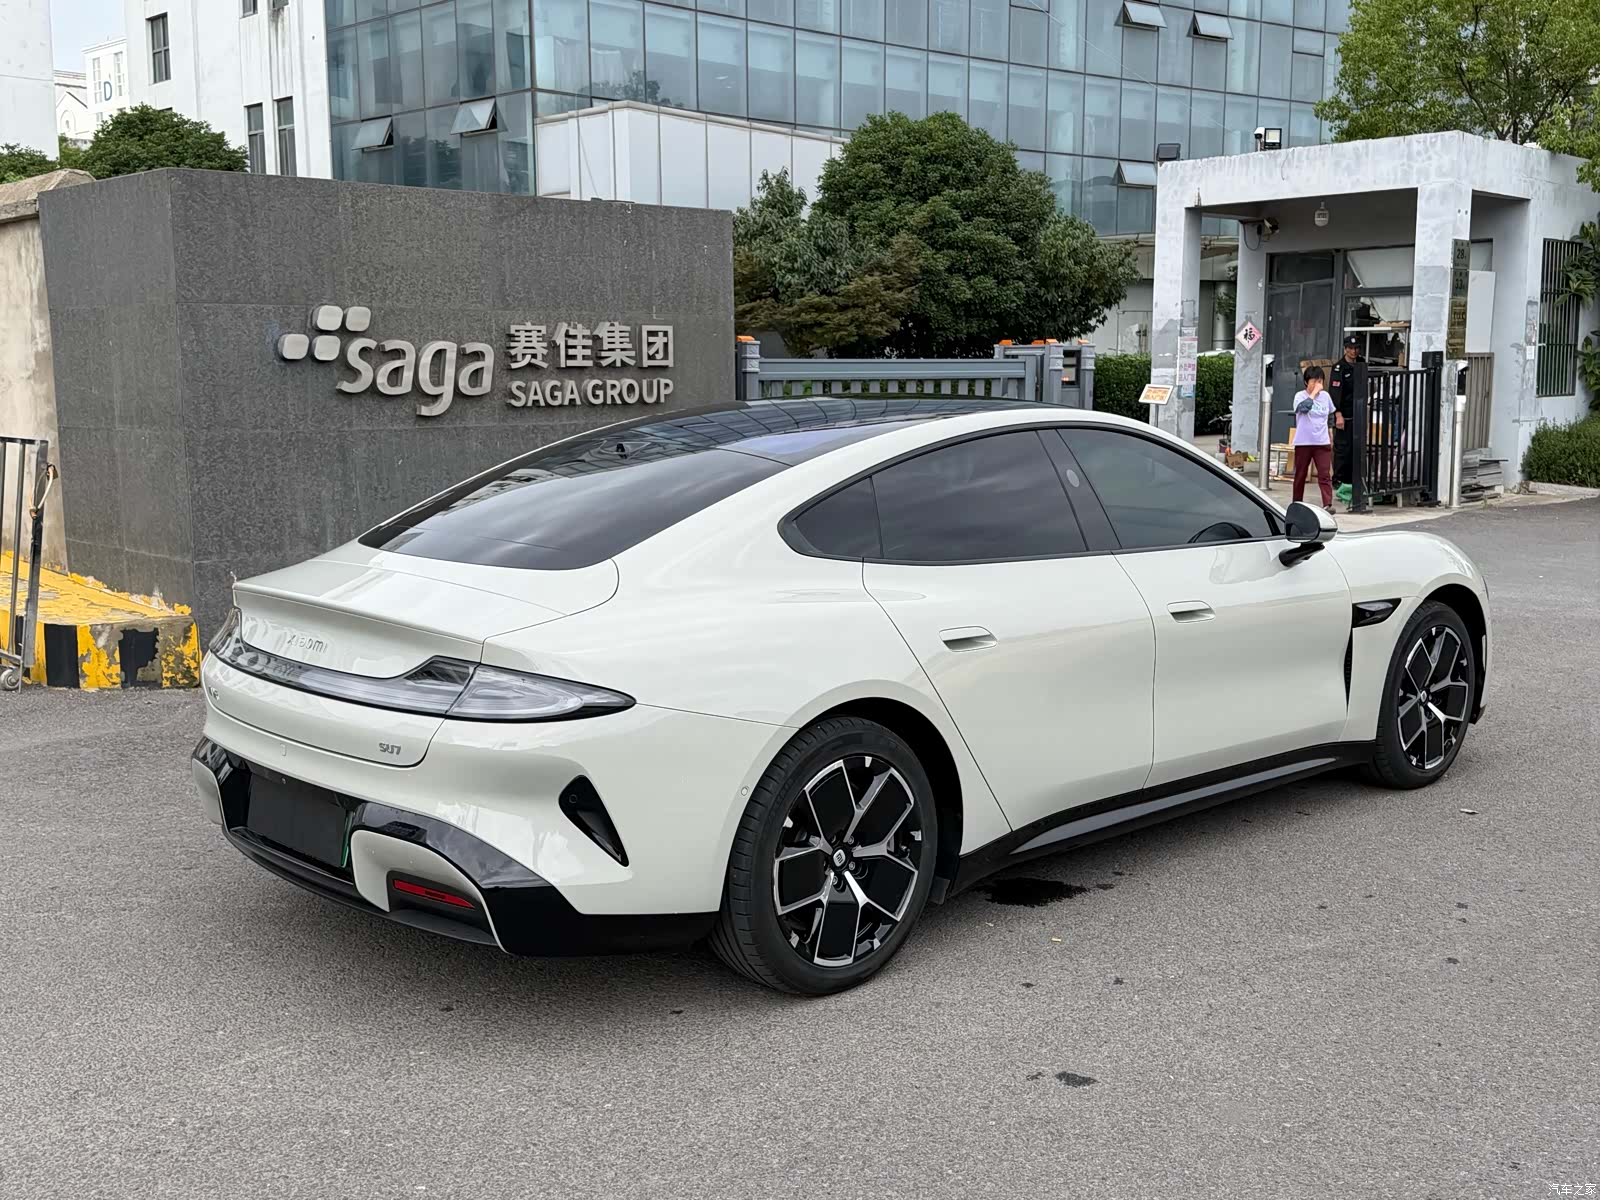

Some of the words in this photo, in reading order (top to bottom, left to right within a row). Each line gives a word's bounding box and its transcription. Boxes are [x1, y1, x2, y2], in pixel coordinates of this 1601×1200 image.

[508, 321, 675, 370] 赛佳集团
[1243, 327, 1256, 343] 福
[336, 337, 496, 417] saga
[508, 380, 582, 407] SAGA
[584, 377, 675, 405] GROUP
[378, 742, 401, 755] SU7
